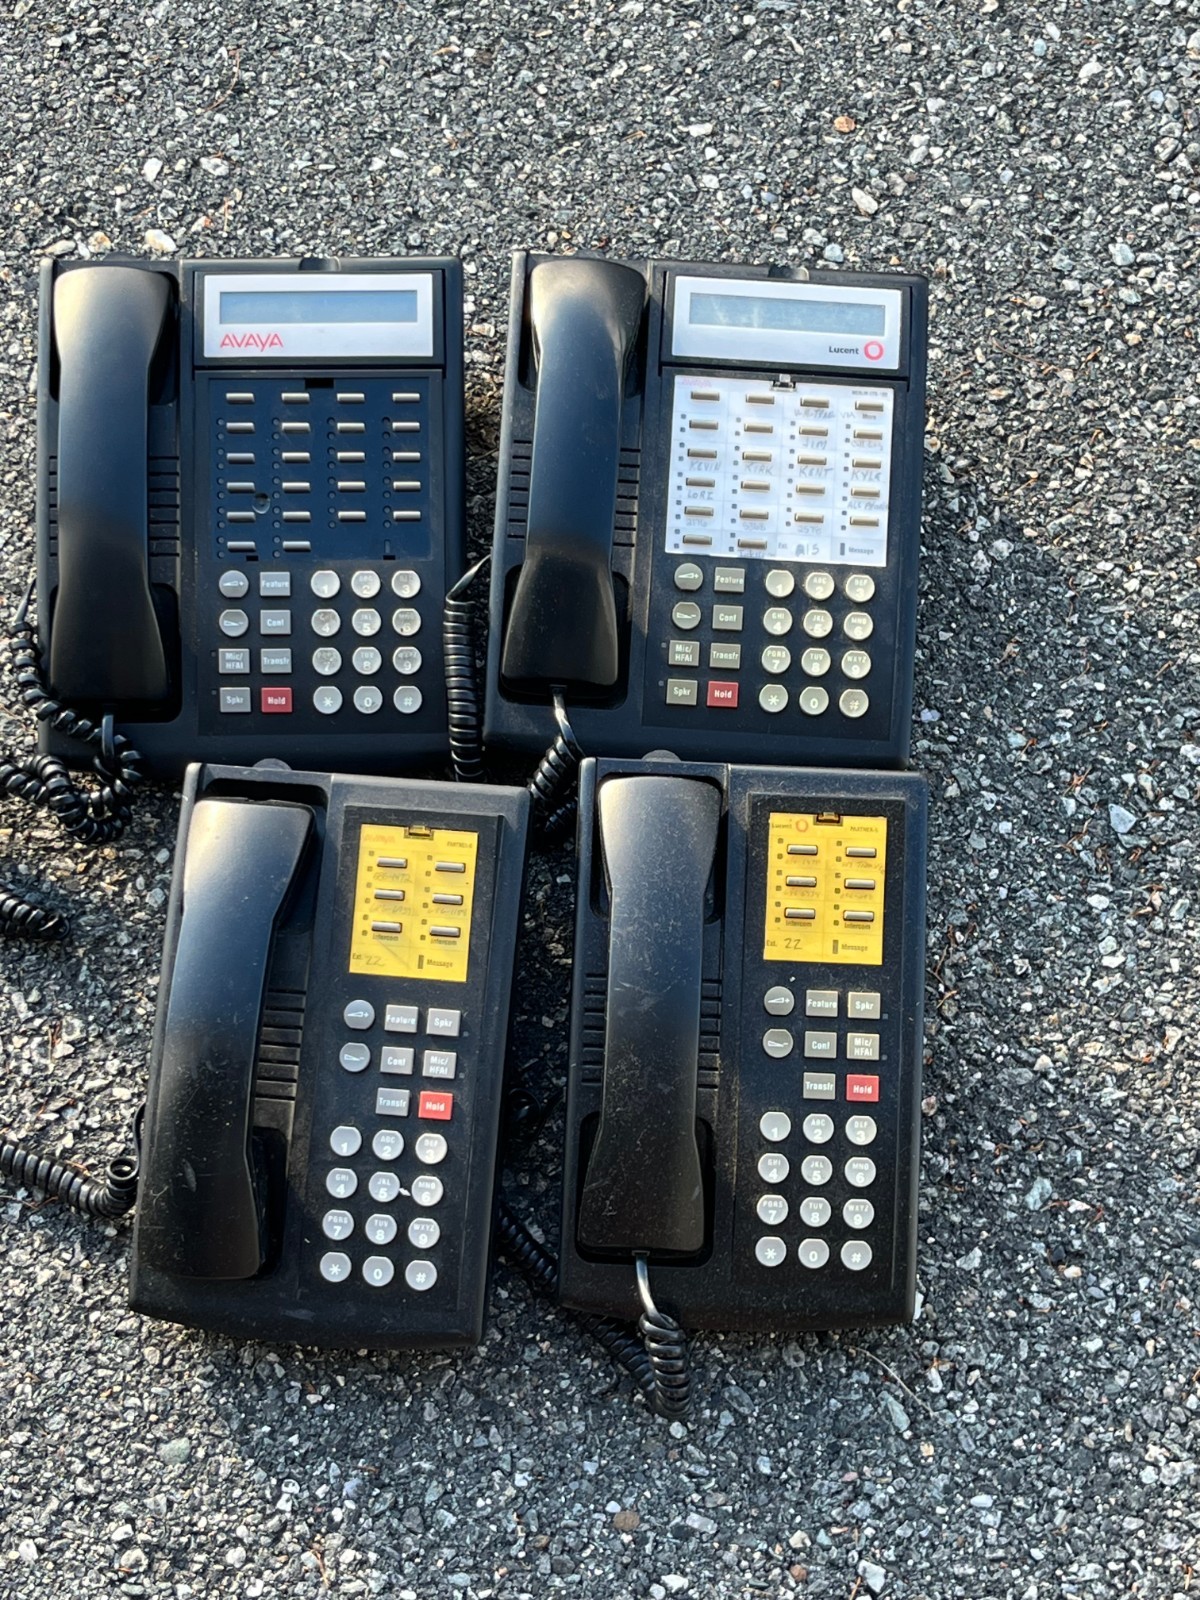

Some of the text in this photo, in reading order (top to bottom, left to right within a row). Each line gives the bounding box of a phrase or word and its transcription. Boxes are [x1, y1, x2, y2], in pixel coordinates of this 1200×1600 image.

[220, 333, 284, 352] AVAYA
[828, 345, 859, 355] Lucent
[848, 547, 874, 555] Message
[715, 576, 744, 584] Feature
[322, 584, 328, 594] 1
[362, 585, 370, 595] 2
[402, 585, 410, 594] 3
[776, 584, 783, 594] 1
[815, 586, 824, 596] 2
[855, 588, 865, 598] 3
[719, 613, 736, 622] Conf
[322, 623, 330, 632] 4
[363, 623, 370, 632] 5
[403, 623, 411, 632] 6
[773, 621, 782, 632] 4
[814, 623, 823, 634] 5
[854, 626, 863, 637] 6
[675, 644, 692, 653] Mic/
[225, 652, 243, 660] Mic/
[675, 653, 692, 662] HFAI
[712, 651, 739, 660] Transfr
[263, 657, 290, 665] Transfr
[363, 661, 371, 670] 8
[404, 661, 411, 670] 9
[772, 660, 780, 670] 7
[324, 662, 331, 671] 7
[811, 662, 820, 672] 8
[851, 665, 860, 675] 9
[673, 687, 691, 696] Spkr
[714, 690, 732, 698] Hold
[226, 696, 243, 704] Spkr
[267, 697, 286, 705] Hold
[364, 697, 372, 707] 0
[810, 698, 818, 708] 0
[844, 922, 871, 930] Intercom
[372, 933, 399, 941] Intercom
[841, 943, 868, 952] Message
[427, 959, 453, 968] Message
[808, 999, 837, 1009] Feature
[855, 1001, 874, 1011] Spkr
[386, 1015, 416, 1025] Feature
[434, 1018, 452, 1028] Spkr
[812, 1041, 830, 1050] Conf
[854, 1037, 872, 1047] Mic/
[854, 1048, 872, 1056] HFAI
[387, 1057, 405, 1065] Conf
[430, 1056, 448, 1066] Mic/
[429, 1066, 447, 1074] HFAI
[805, 1081, 834, 1091] Transfr
[853, 1085, 872, 1094] Hold
[379, 1098, 406, 1107] Transfr
[426, 1102, 445, 1111] Hold
[771, 1128, 778, 1138] 1
[814, 1129, 823, 1140] 2
[856, 1131, 865, 1141] 3
[341, 1142, 348, 1153] 1
[424, 1139, 438, 1147] DEF
[382, 1146, 392, 1156] 2
[426, 1149, 434, 1160] 3
[852, 1163, 869, 1171] MNO
[768, 1168, 778, 1179] 4
[812, 1171, 821, 1182] 5
[856, 1172, 865, 1183] 6
[377, 1178, 391, 1186] JKL
[418, 1181, 436, 1189] MNO
[336, 1184, 345, 1195] 4
[378, 1188, 388, 1198] 5
[421, 1192, 431, 1202] 6
[809, 1202, 823, 1210] TUV
[768, 1210, 777, 1221] 7
[811, 1212, 820, 1223] 8
[853, 1214, 863, 1225] 9
[374, 1219, 389, 1227] TUV
[333, 1226, 342, 1236] 7
[375, 1229, 385, 1240] 8
[418, 1233, 428, 1245] 9
[809, 1251, 818, 1262] 0
[373, 1269, 383, 1280] 0
